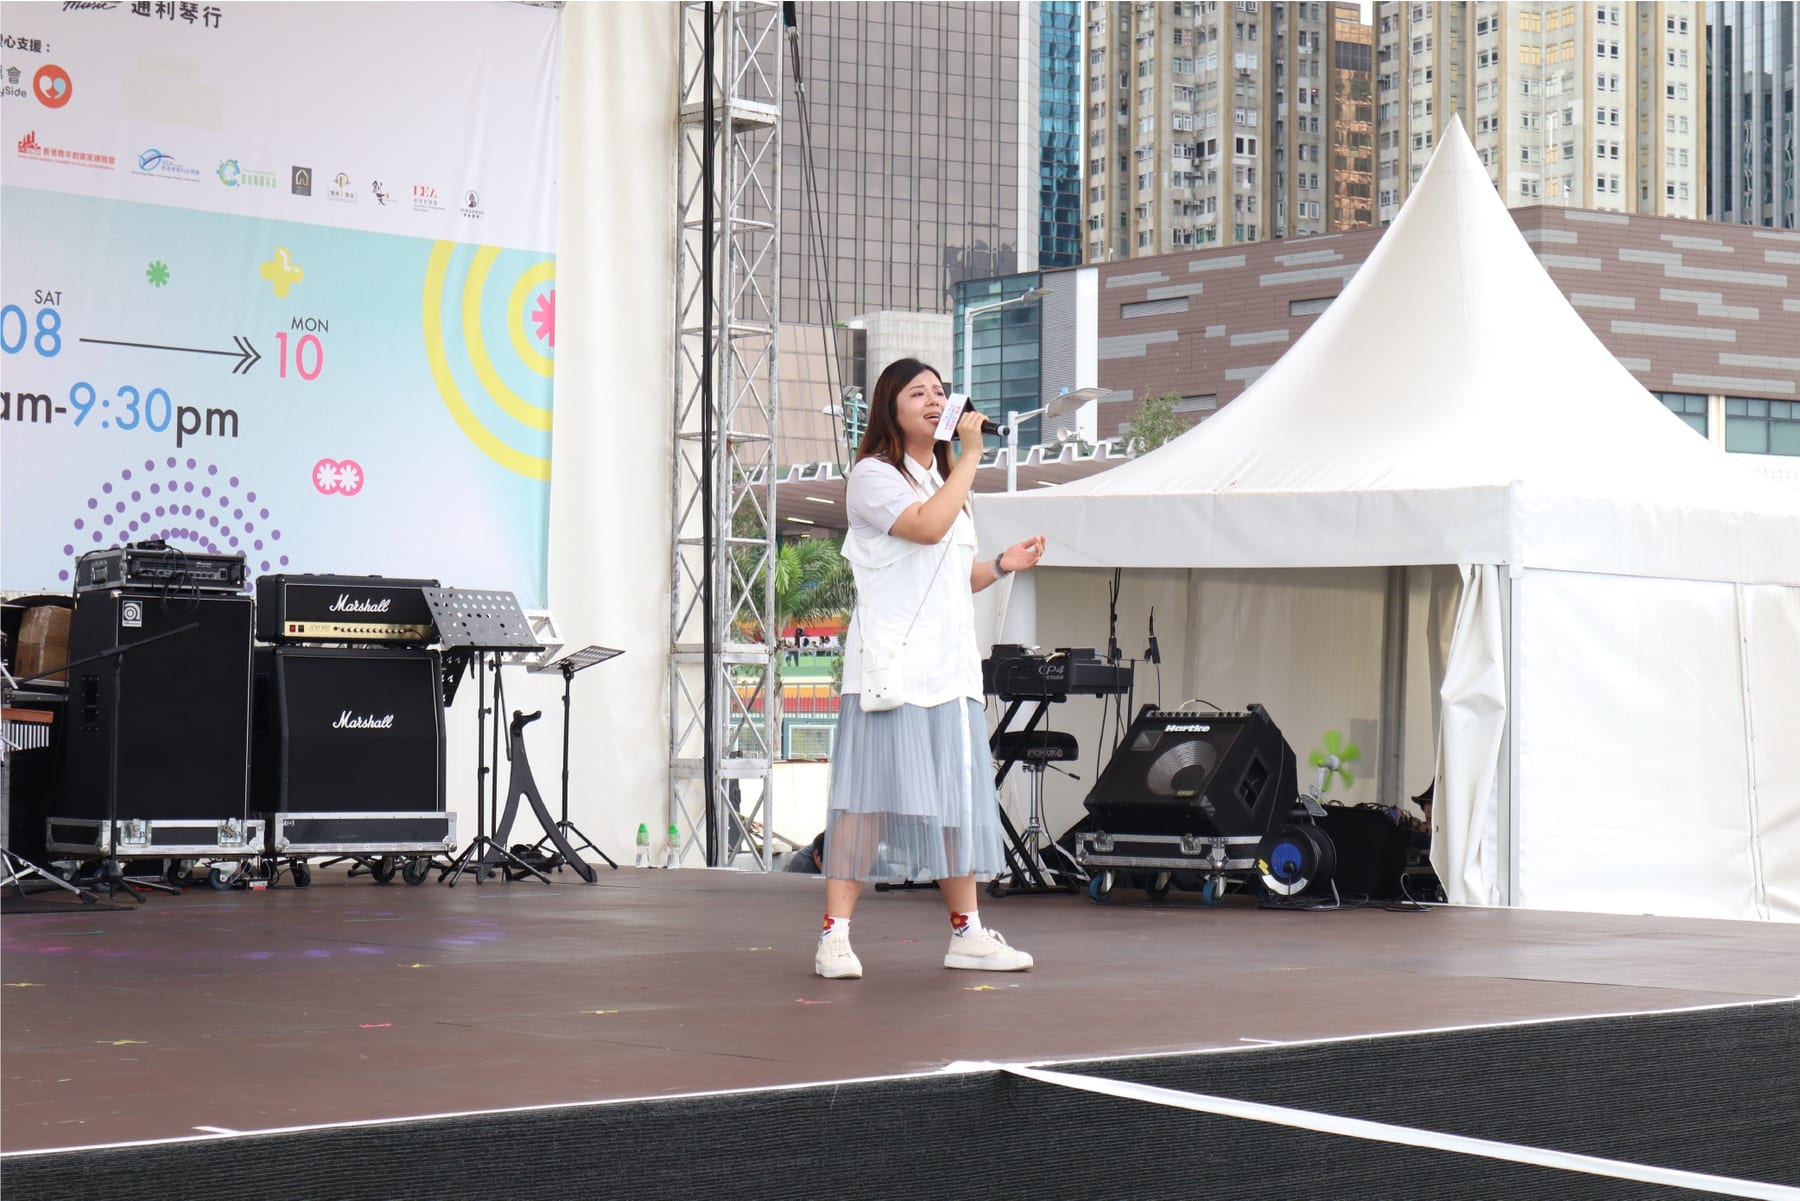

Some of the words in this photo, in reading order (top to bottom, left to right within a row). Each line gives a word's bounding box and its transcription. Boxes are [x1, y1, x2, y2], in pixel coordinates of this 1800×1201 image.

[131, 1, 222, 28] 通利琴行
[0, 34, 50, 53] 心支援：
[34, 289, 62, 306] SAT
[0, 304, 62, 358] 08
[291, 316, 328, 333] MON
[275, 331, 323, 381] 10
[329, 593, 391, 613] Marshall
[1038, 665, 1065, 675] CP4
[332, 710, 394, 729] Marshall
[1164, 724, 1211, 732] Hartke
